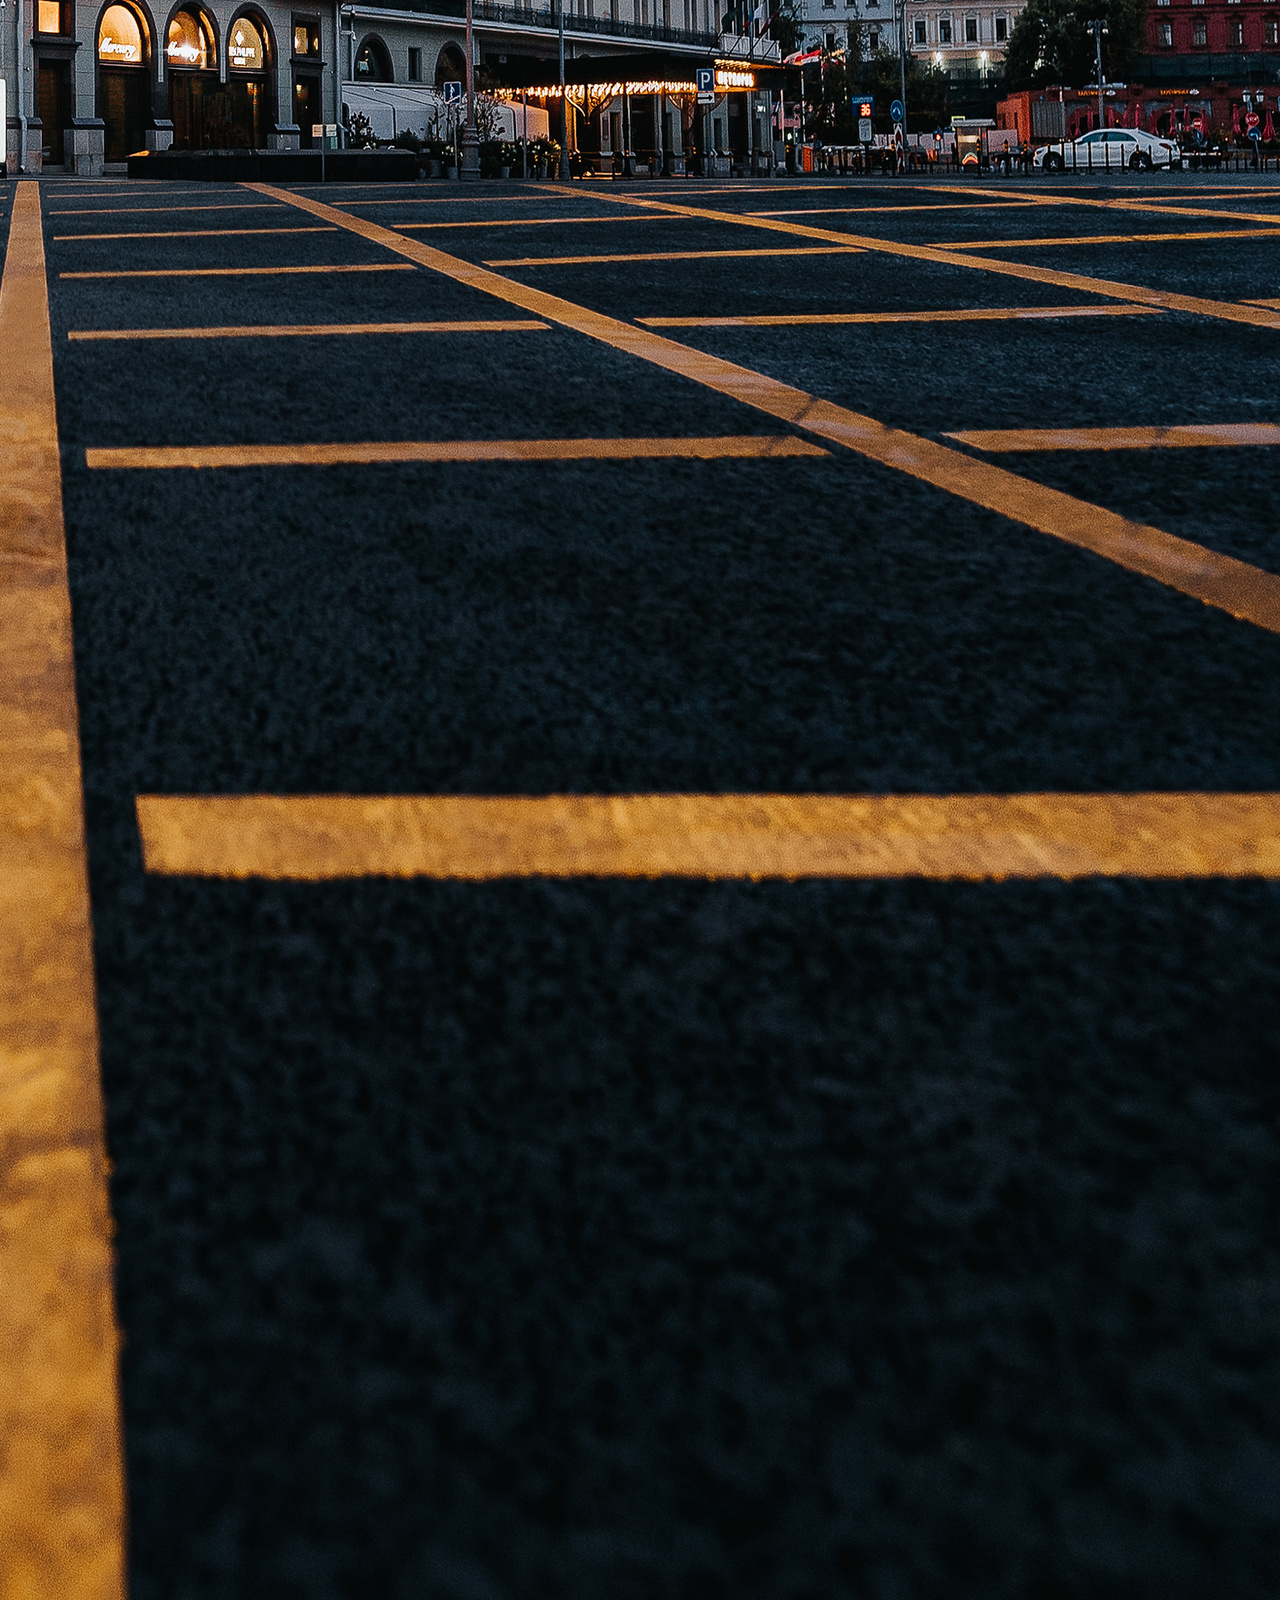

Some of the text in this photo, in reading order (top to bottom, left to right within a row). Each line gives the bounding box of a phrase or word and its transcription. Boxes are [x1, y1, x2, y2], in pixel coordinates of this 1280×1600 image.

[99, 37, 136, 59] Mercury
[168, 41, 200, 62] Mery
[701, 72, 710, 89] P
